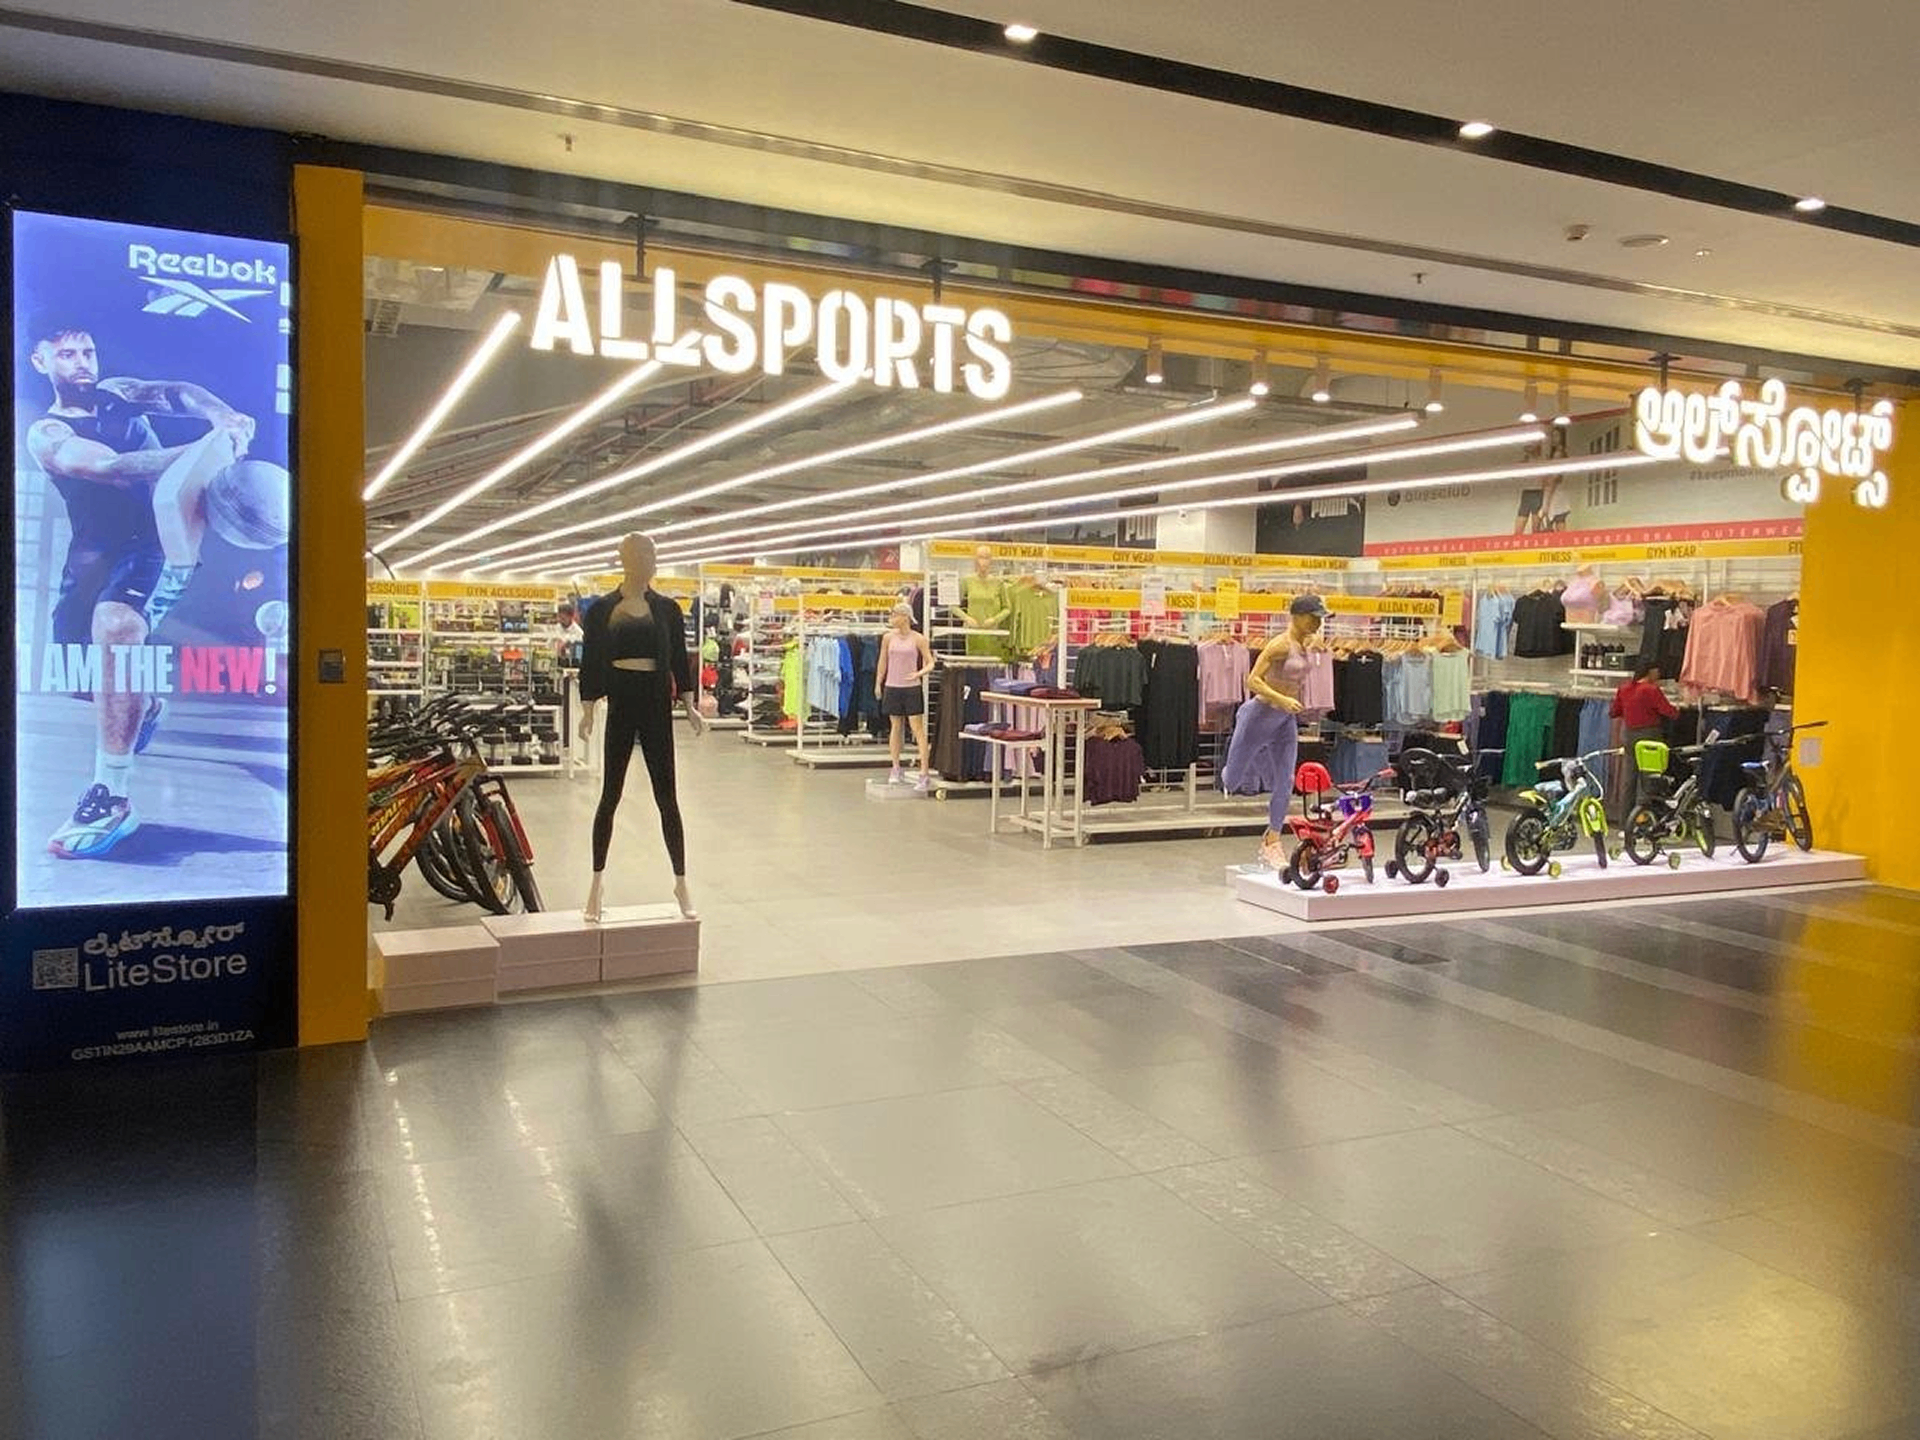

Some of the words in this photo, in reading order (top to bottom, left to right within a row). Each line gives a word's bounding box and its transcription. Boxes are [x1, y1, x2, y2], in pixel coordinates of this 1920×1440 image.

[129, 244, 277, 285] Reebok
[531, 254, 1012, 400] ALLSPORTS
[1573, 533, 1631, 546] SPORTS
[1643, 532, 1672, 543] BRA
[1000, 547, 1018, 557] CITY
[1021, 547, 1044, 558] WEAR
[1113, 551, 1131, 563] CITY
[1133, 553, 1154, 564] WEAR
[1539, 551, 1572, 563] FITNESS
[1647, 546, 1667, 559] GYM
[1669, 545, 1696, 558] WEAR
[1377, 602, 1409, 614] ALLDAY
[1412, 603, 1435, 614] WEAR
[40, 643, 102, 693] AM
[109, 644, 173, 693] THE
[84, 953, 248, 992] LiteStore
